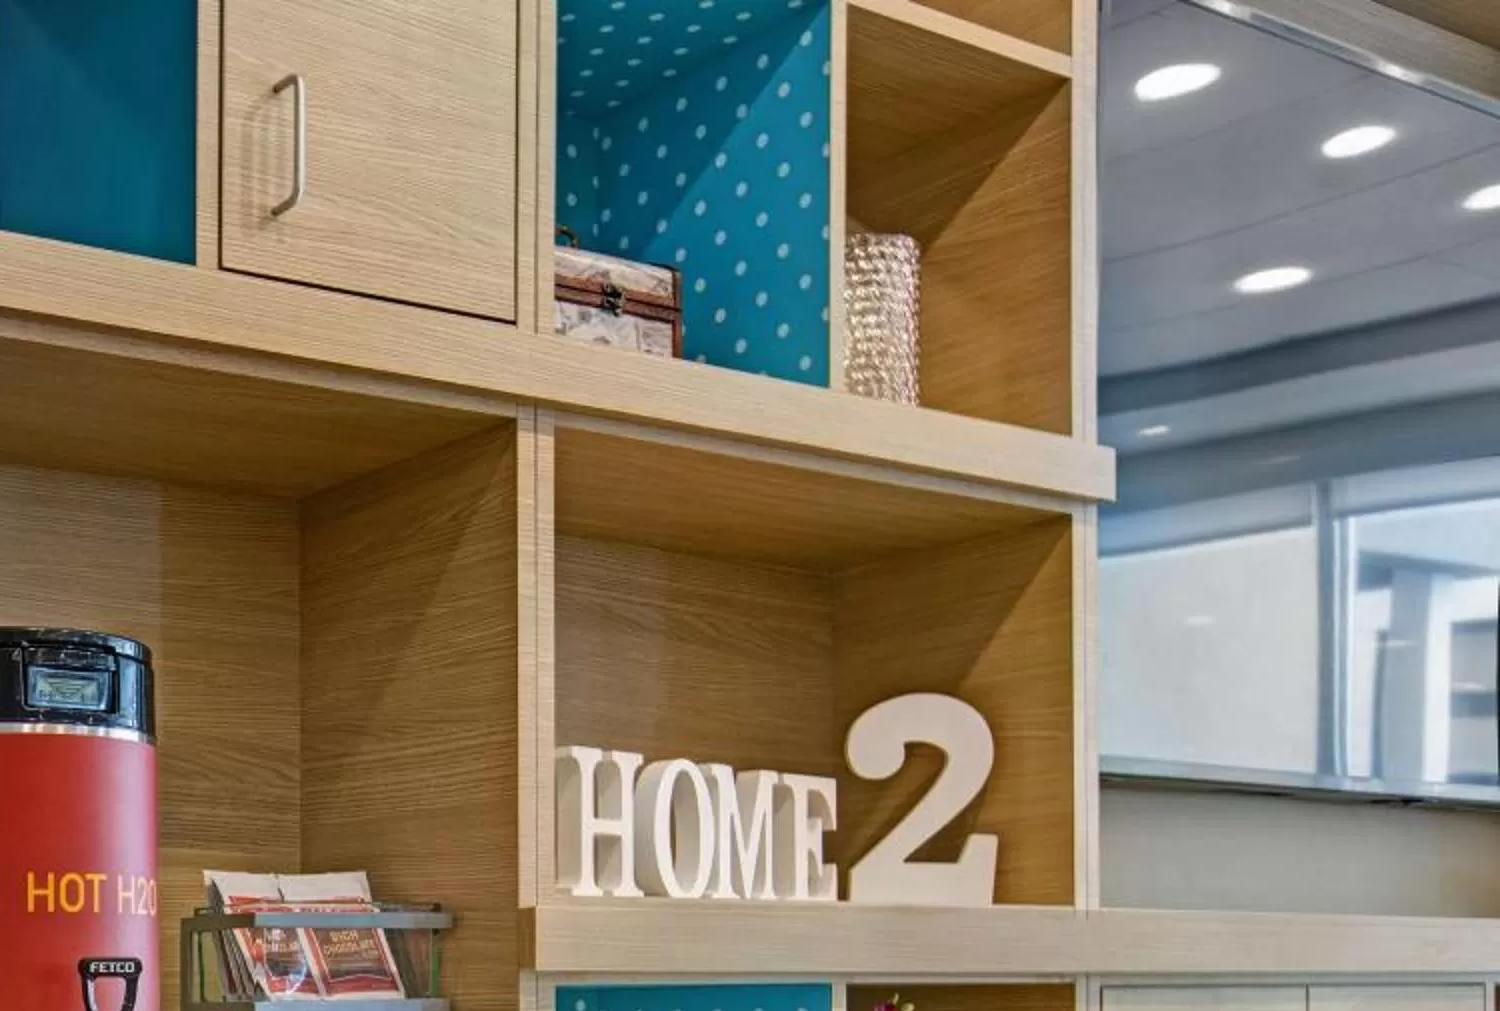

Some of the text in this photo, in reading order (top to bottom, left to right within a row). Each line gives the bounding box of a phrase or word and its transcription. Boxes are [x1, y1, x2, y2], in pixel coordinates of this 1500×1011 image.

[556, 692, 998, 906] HOME 2
[27, 871, 107, 913] HOT
[89, 961, 136, 973] FETCO
